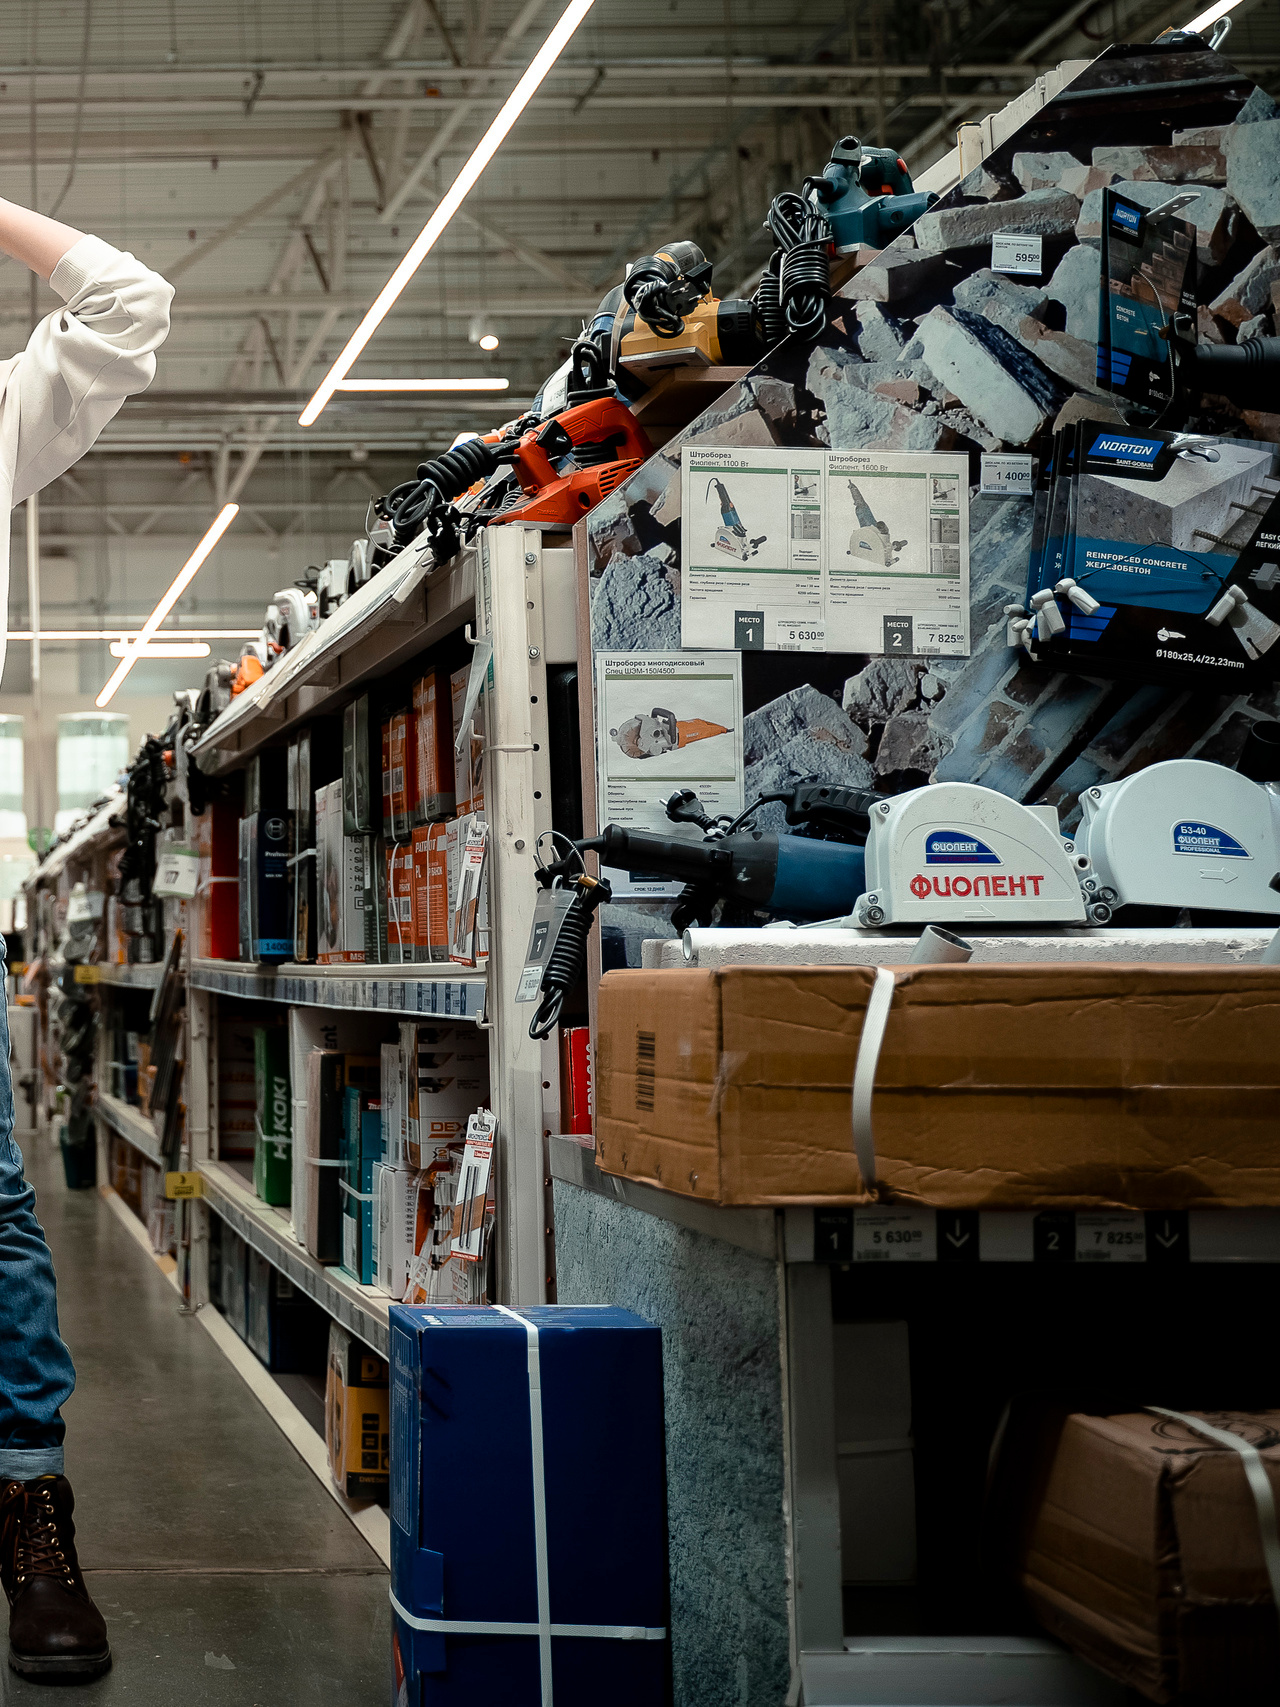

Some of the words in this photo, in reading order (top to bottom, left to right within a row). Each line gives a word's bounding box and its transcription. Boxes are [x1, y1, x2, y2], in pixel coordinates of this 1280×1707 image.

[1115, 208, 1138, 225] NORTON
[1115, 304, 1137, 319] CONCRETE
[1098, 440, 1154, 456] NORTON
[689, 451, 732, 460] Штроборез
[828, 455, 871, 464] Штроборез
[689, 459, 721, 468] Фиолент,
[740, 460, 749, 468] Вт
[828, 463, 860, 472] Фиолент,
[862, 464, 879, 472] 1600
[1115, 458, 1154, 468] SAINT-GOBAIN
[1261, 532, 1277, 541] EASY
[1255, 540, 1280, 551] ЛЕГКИЙ
[1142, 558, 1188, 571] CONCRETE
[745, 628, 754, 642] 1
[789, 630, 796, 640] 5
[892, 633, 903, 647] 2
[928, 633, 935, 642] 7
[605, 660, 646, 668] Штроборез
[647, 659, 705, 668] многодисковый
[1180, 825, 1207, 836] Б3-40
[415, 838, 436, 854] PATROT
[930, 841, 979, 853] ФИОЛЕНТ
[1176, 835, 1221, 847] ФИОЛЕНТ
[1179, 845, 1222, 855] PROFESSIONAL
[909, 872, 1045, 900] ФИОЛЕНТ
[536, 939, 542, 953] 1
[828, 1231, 838, 1250] 1
[873, 1231, 883, 1244] 5
[1046, 1231, 1060, 1251] 2
[1094, 1231, 1103, 1244] 7
